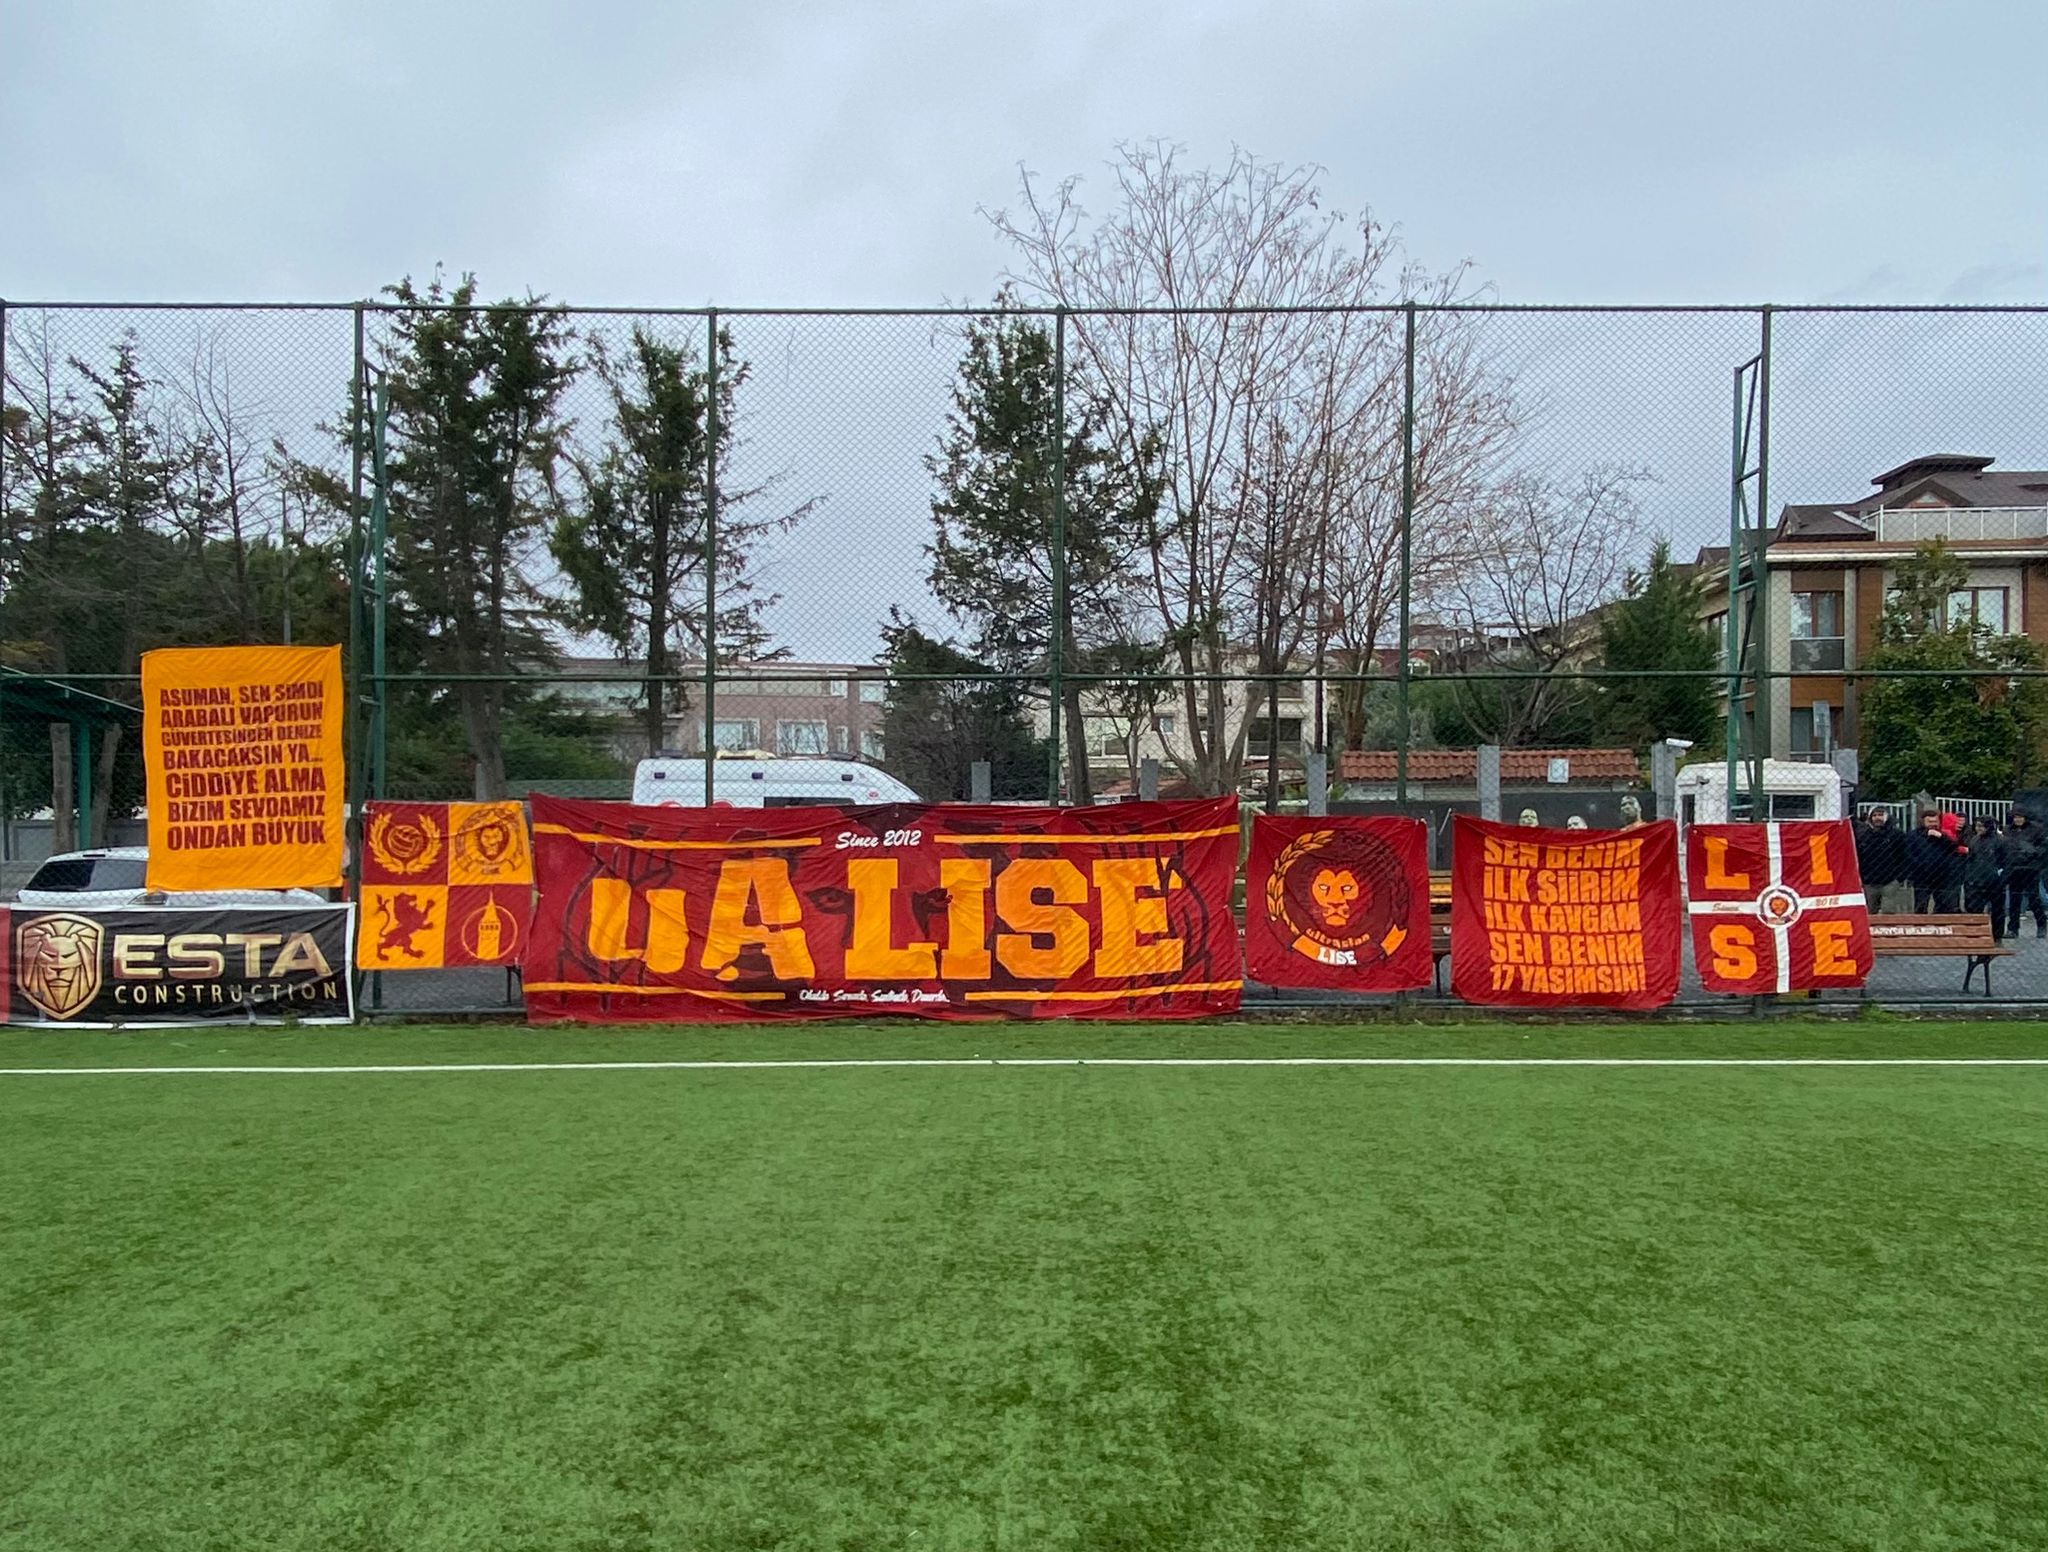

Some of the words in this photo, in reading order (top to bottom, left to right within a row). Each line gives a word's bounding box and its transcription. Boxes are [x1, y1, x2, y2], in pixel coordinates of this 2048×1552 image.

[239, 684, 271, 704] SEN
[161, 707, 235, 728] ARABALI
[239, 701, 323, 725] VAPURUN
[265, 767, 326, 793] ALMA
[230, 795, 326, 820] SEVDAMIZ
[167, 823, 246, 851] ONDAN
[835, 831, 879, 850] Since
[883, 829, 922, 847] 2012
[1530, 901, 1642, 933] KAVGAM
[113, 932, 333, 979] ESTA
[1488, 931, 1544, 964] SEN
[1490, 963, 1515, 991] 17
[114, 981, 338, 1005] CONSTRUCTION
